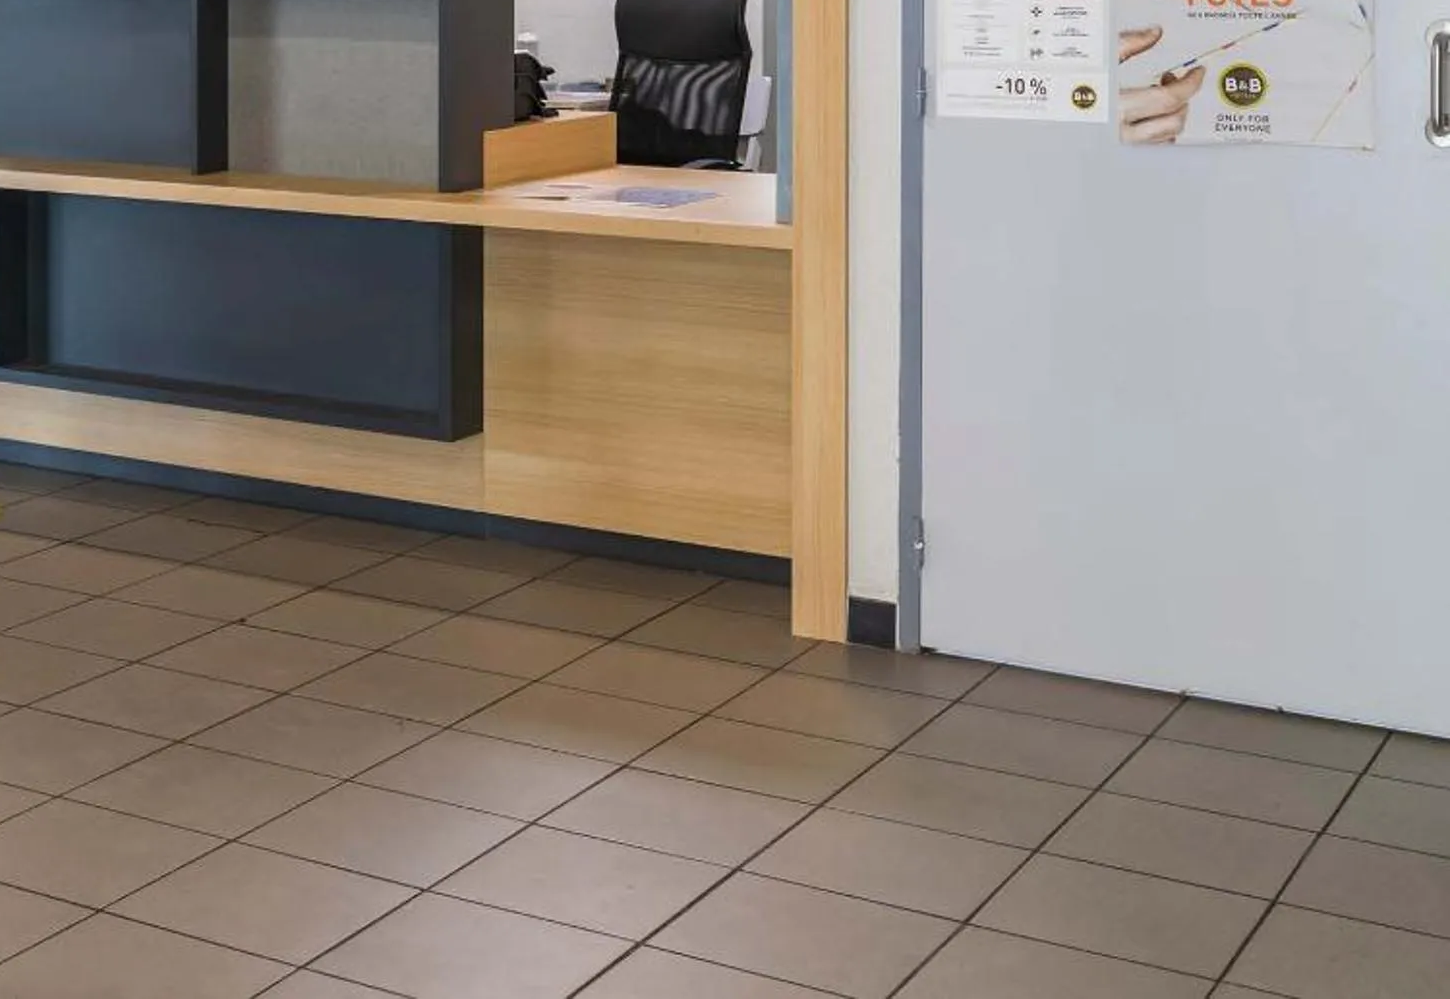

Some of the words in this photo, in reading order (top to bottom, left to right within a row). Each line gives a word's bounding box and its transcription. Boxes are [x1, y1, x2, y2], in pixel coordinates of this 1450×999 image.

[996, 77, 1026, 95] -10
[1225, 77, 1261, 93] B&B
[1216, 114, 1244, 123] ONLY
